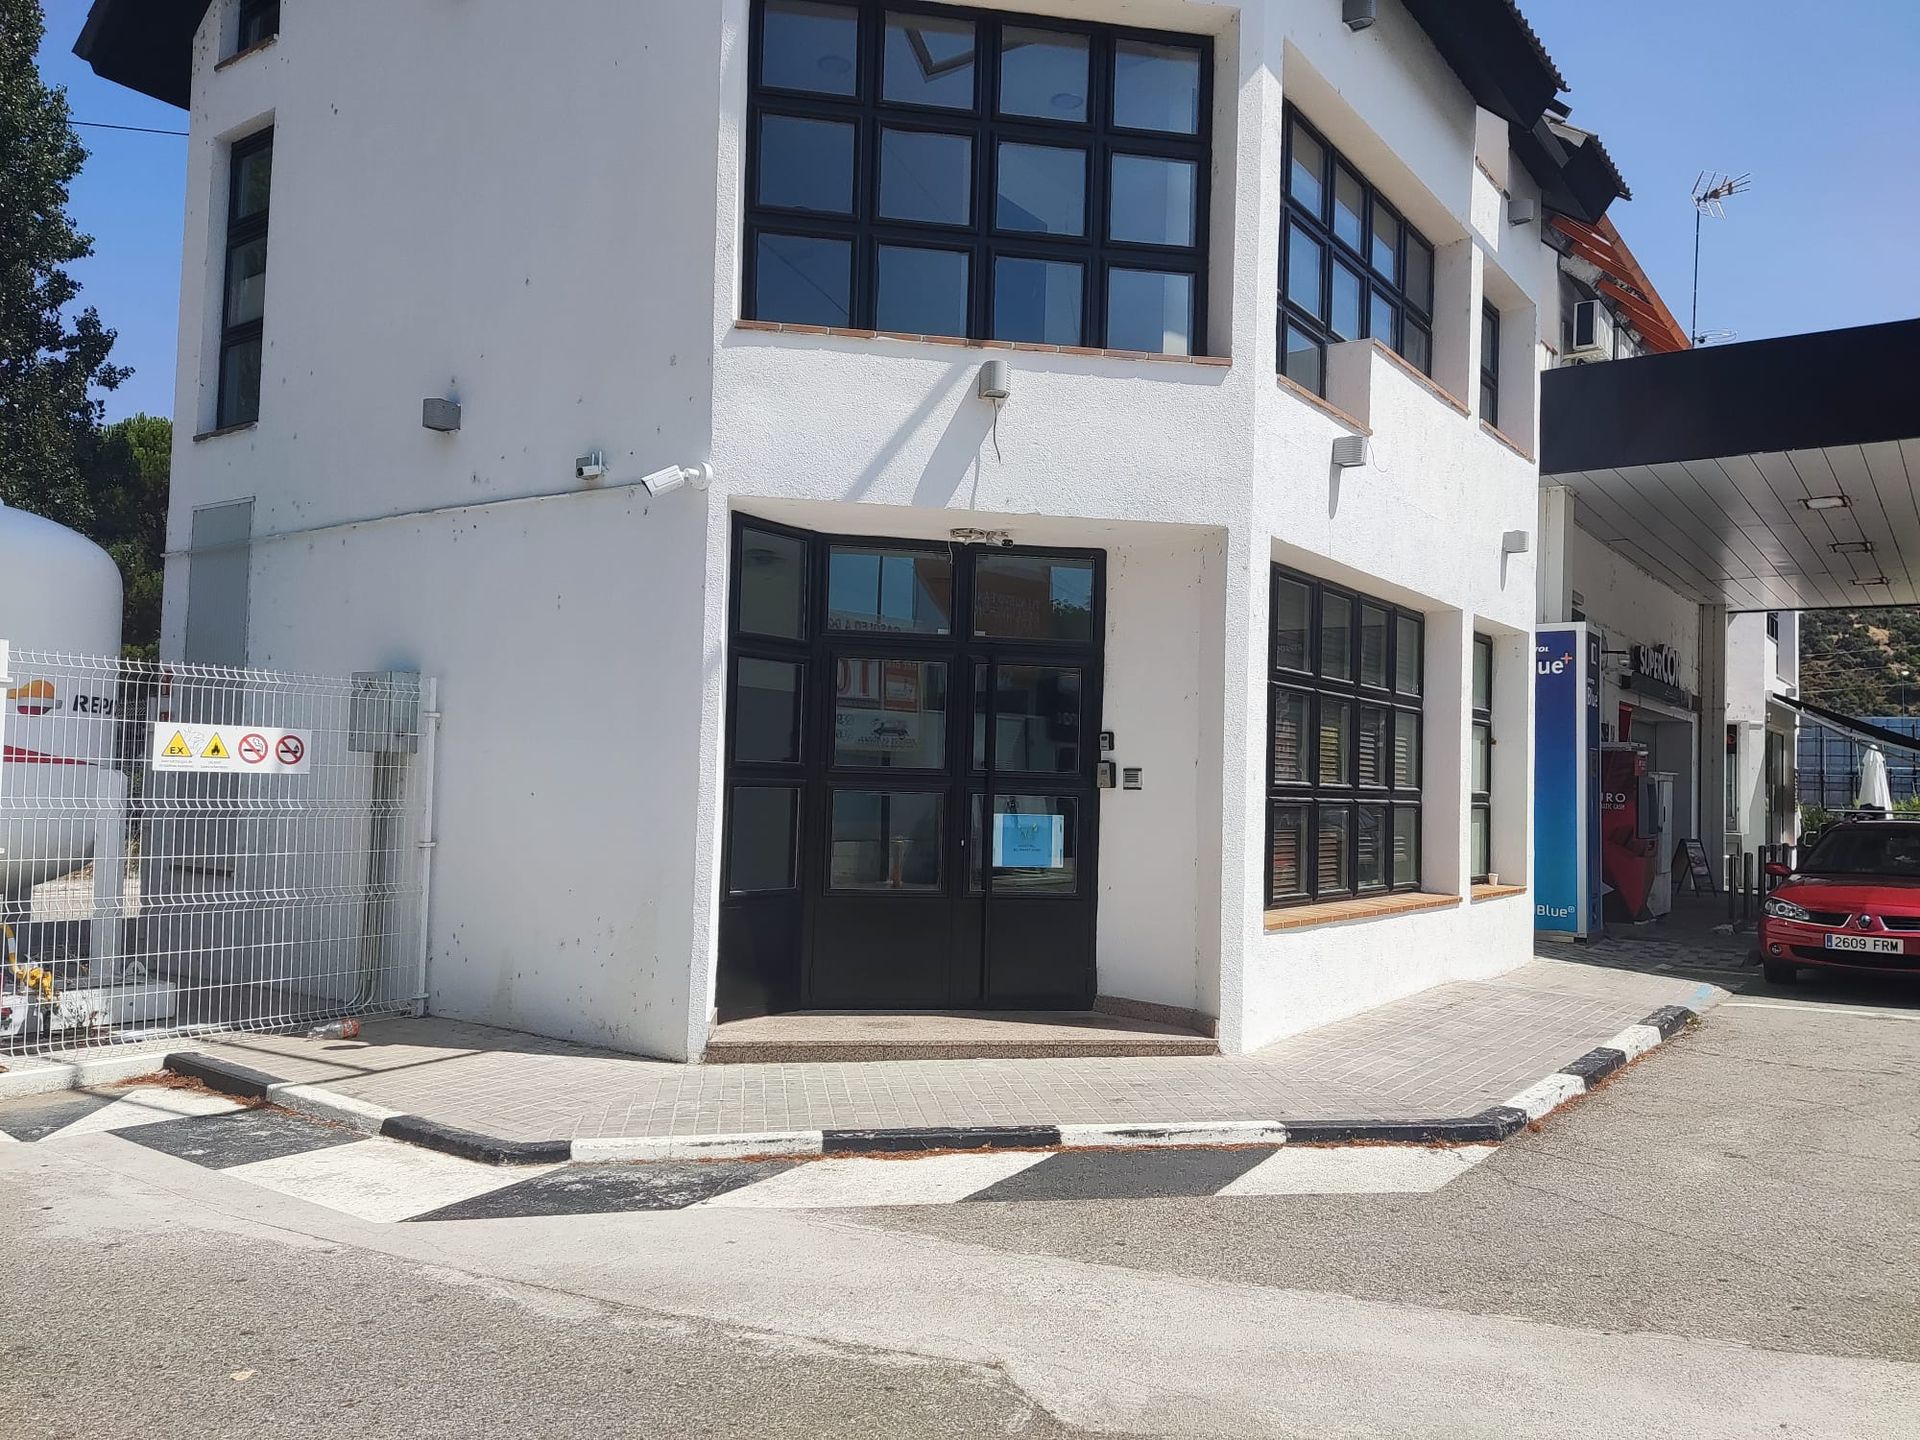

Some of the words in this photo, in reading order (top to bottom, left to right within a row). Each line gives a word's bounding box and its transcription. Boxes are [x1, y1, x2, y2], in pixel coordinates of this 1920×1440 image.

[169, 746, 185, 755] EX
[1835, 936, 1867, 950] 2609
[1873, 939, 1899, 953] FRM
